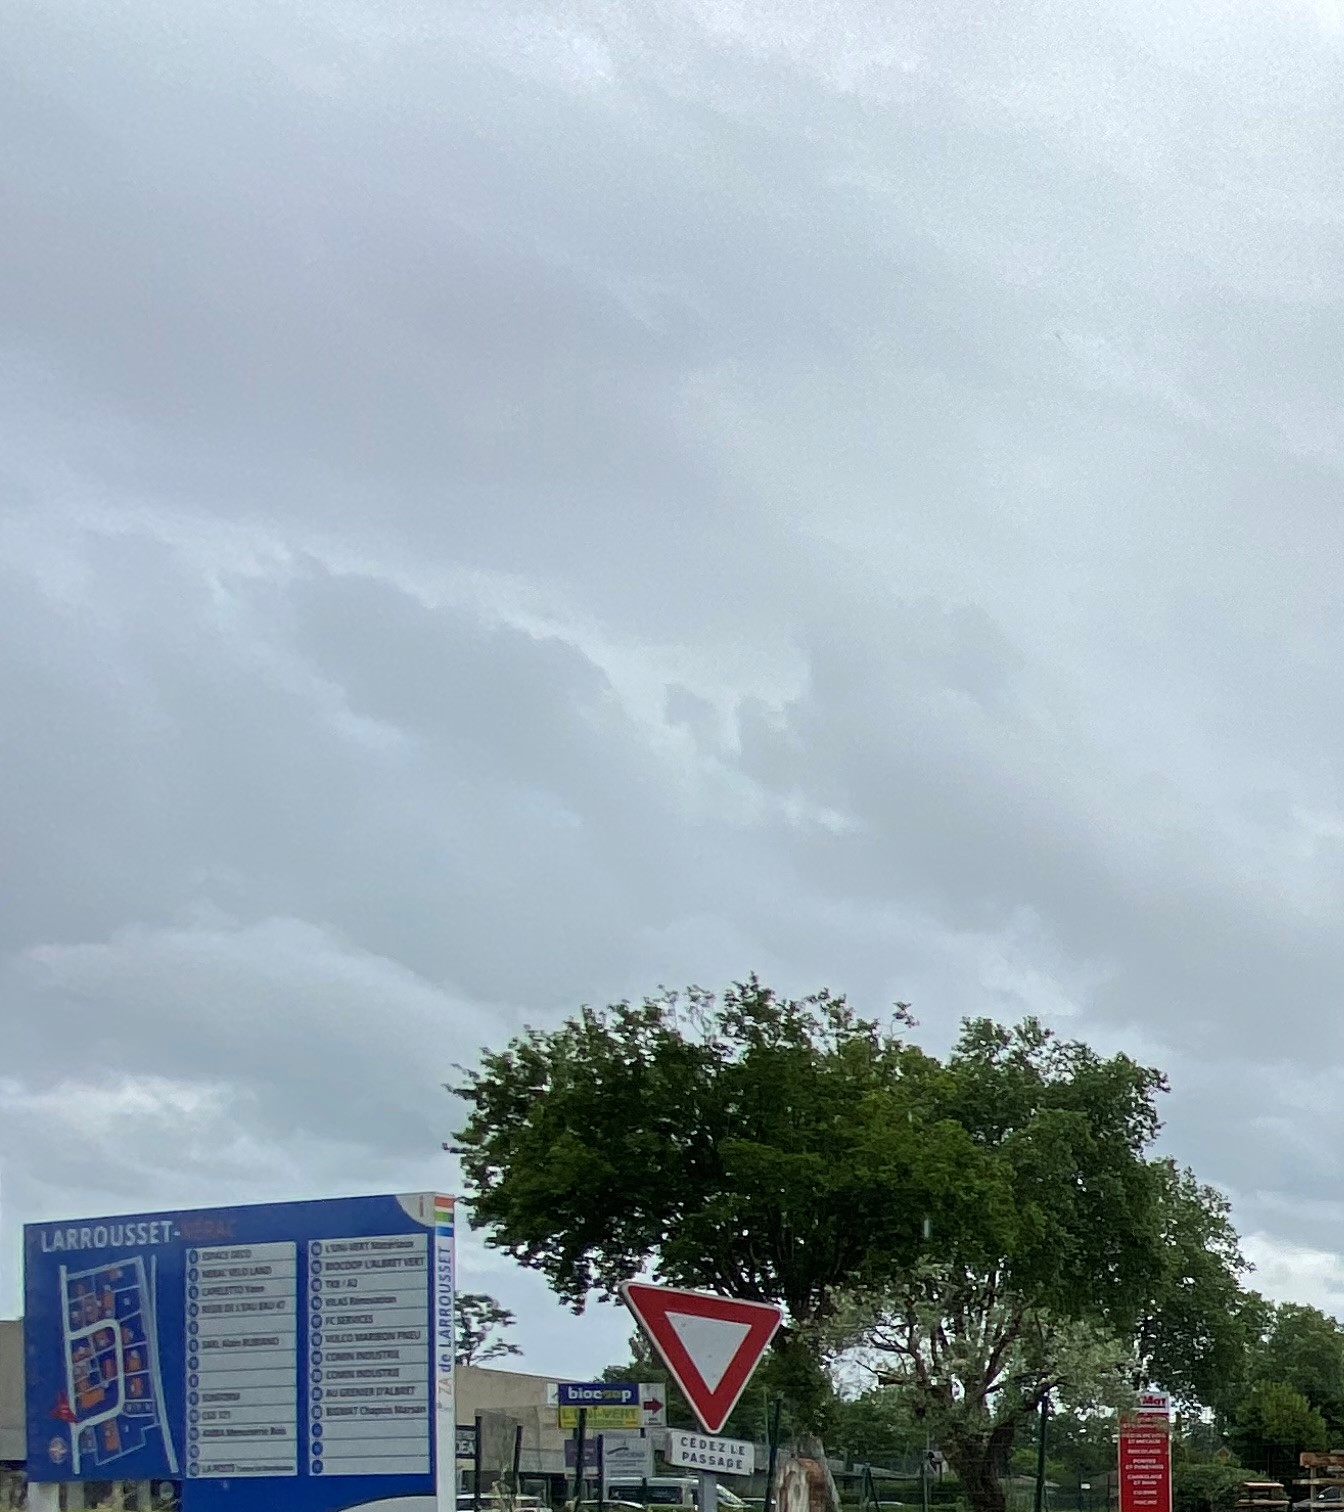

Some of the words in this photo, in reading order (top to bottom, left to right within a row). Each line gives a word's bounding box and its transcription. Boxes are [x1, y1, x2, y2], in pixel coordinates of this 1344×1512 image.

[438, 1246, 452, 1348] LARROUSSET
[438, 1354, 451, 1373] de
[730, 1444, 746, 1456] LE
[682, 1451, 743, 1470] PASSAGE
